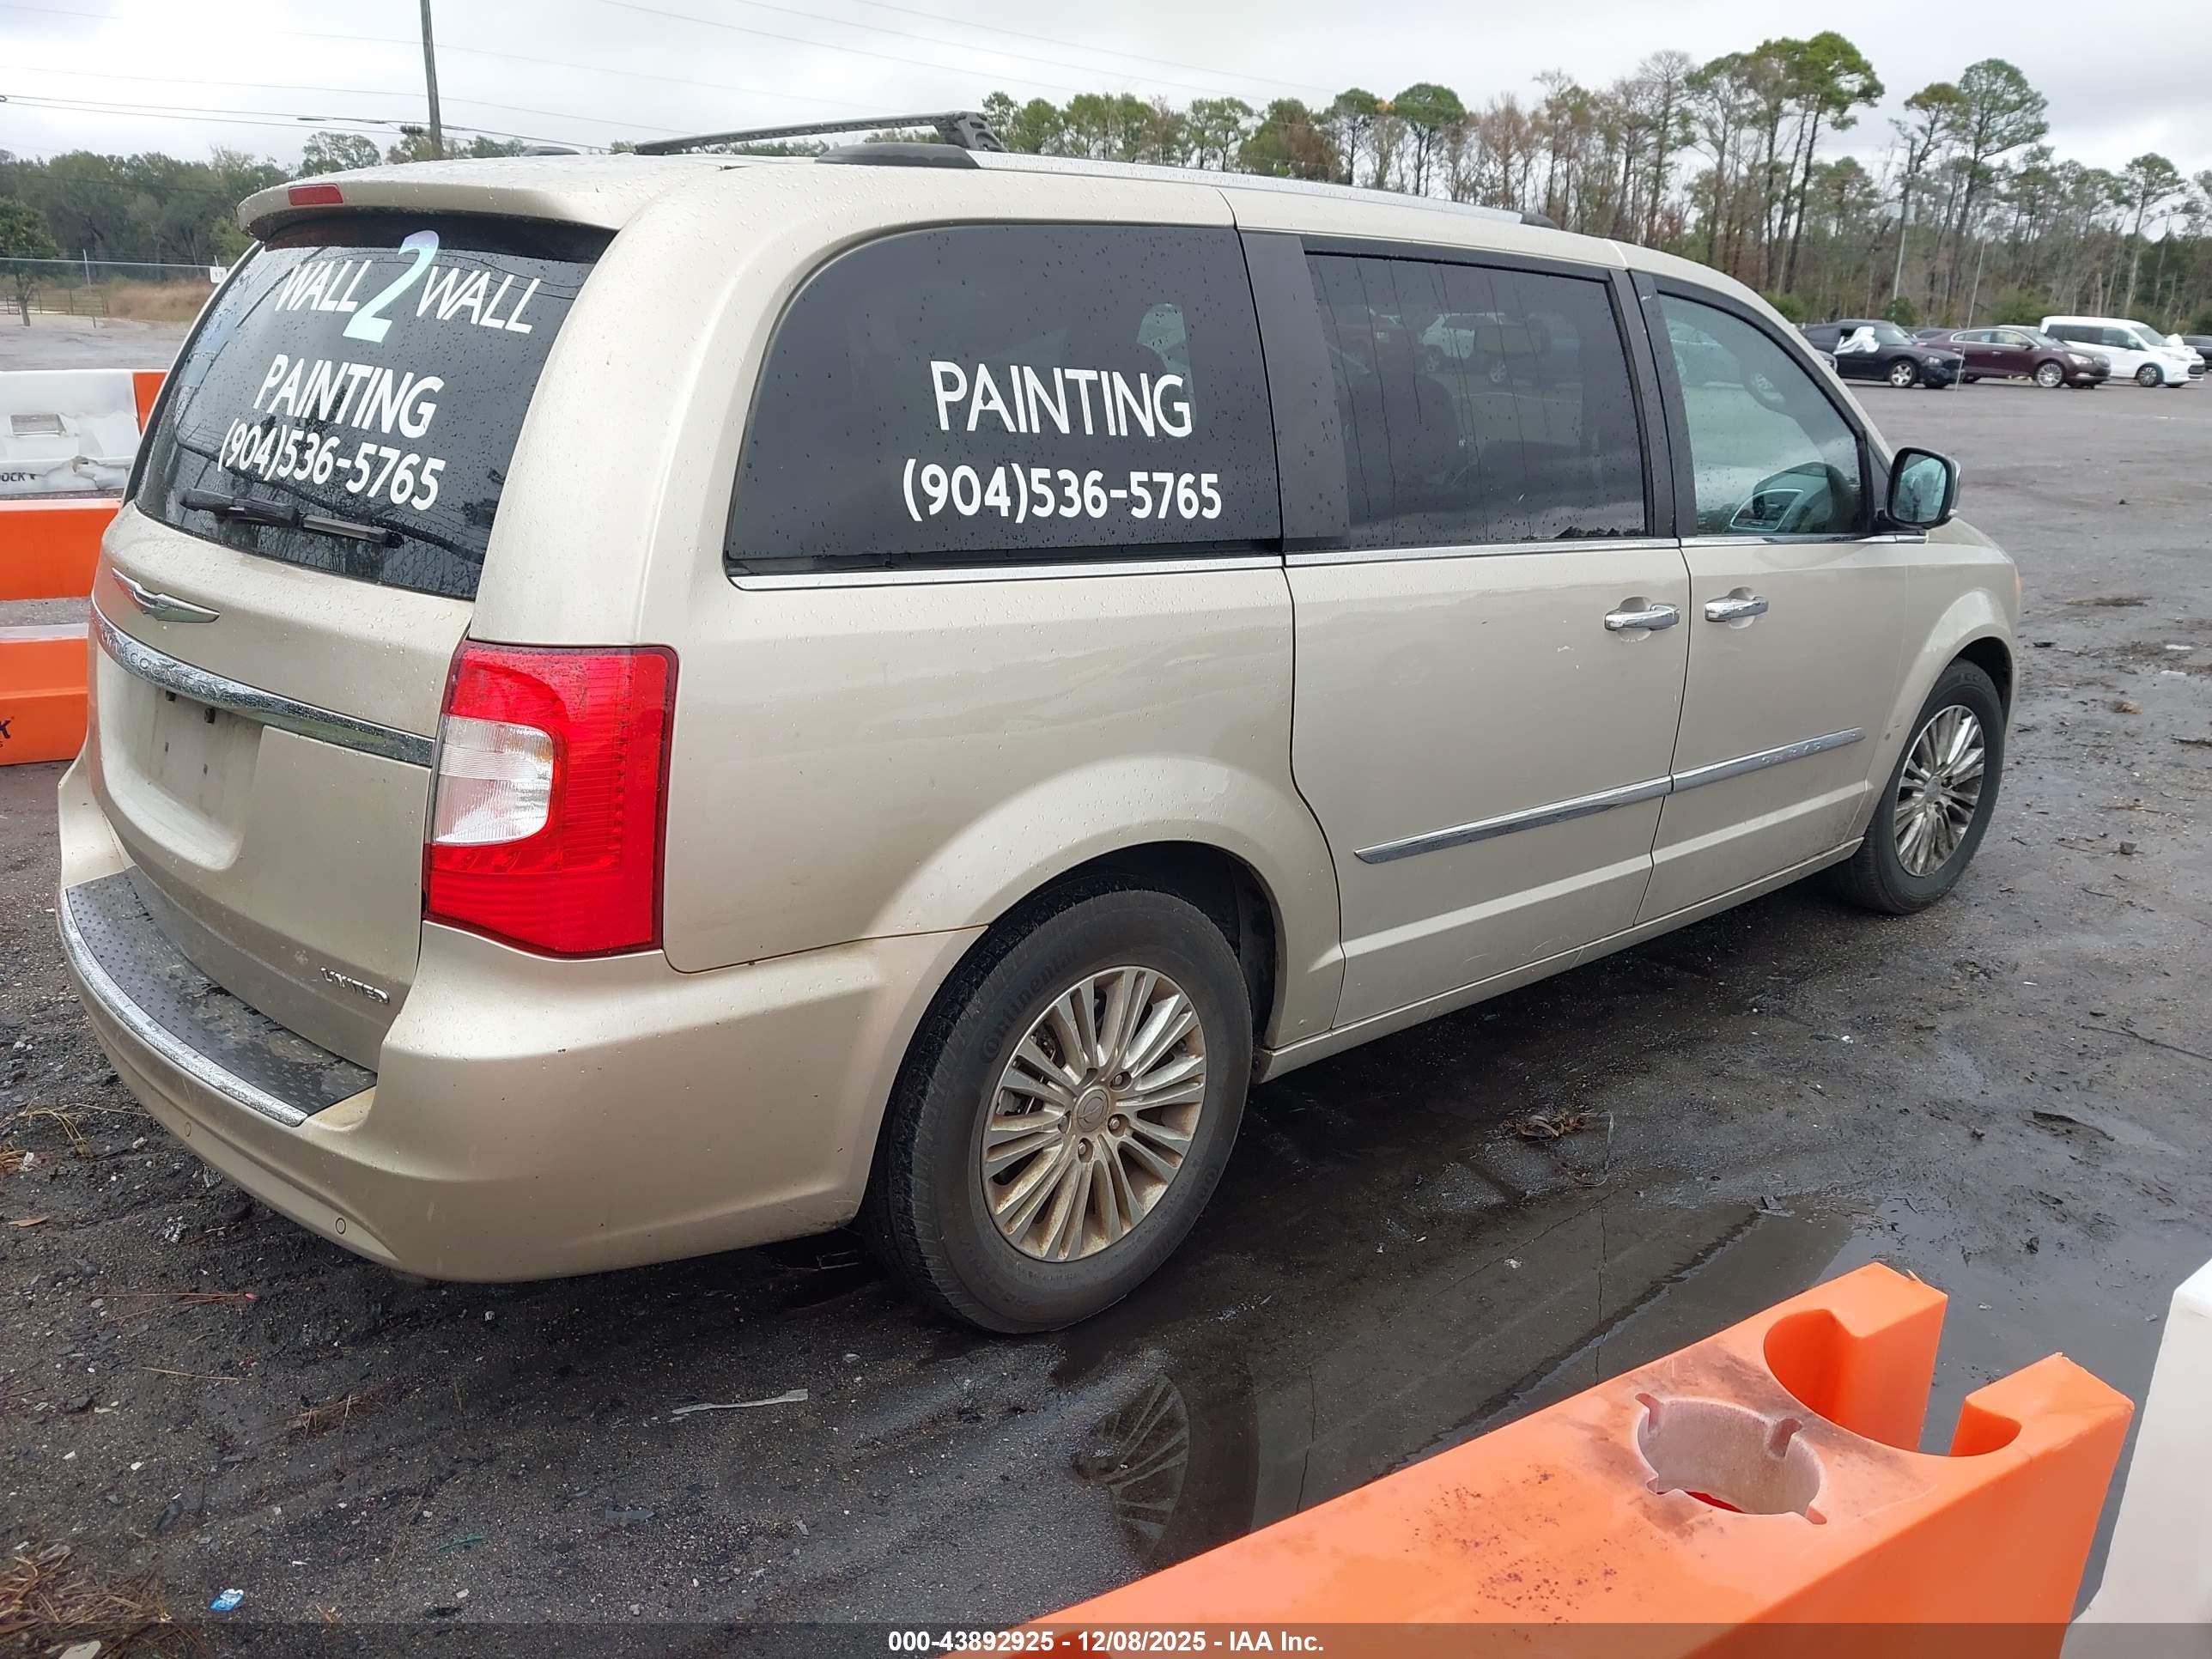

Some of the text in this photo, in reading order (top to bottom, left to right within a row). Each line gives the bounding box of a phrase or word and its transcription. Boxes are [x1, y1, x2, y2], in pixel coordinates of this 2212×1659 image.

[274, 230, 542, 343] WALL 2 WALL
[252, 353, 445, 439] PAINTING
[930, 361, 1193, 438] PAINTING
[216, 417, 447, 511] (904)536-5765
[902, 458, 1223, 524] (904)536-5765
